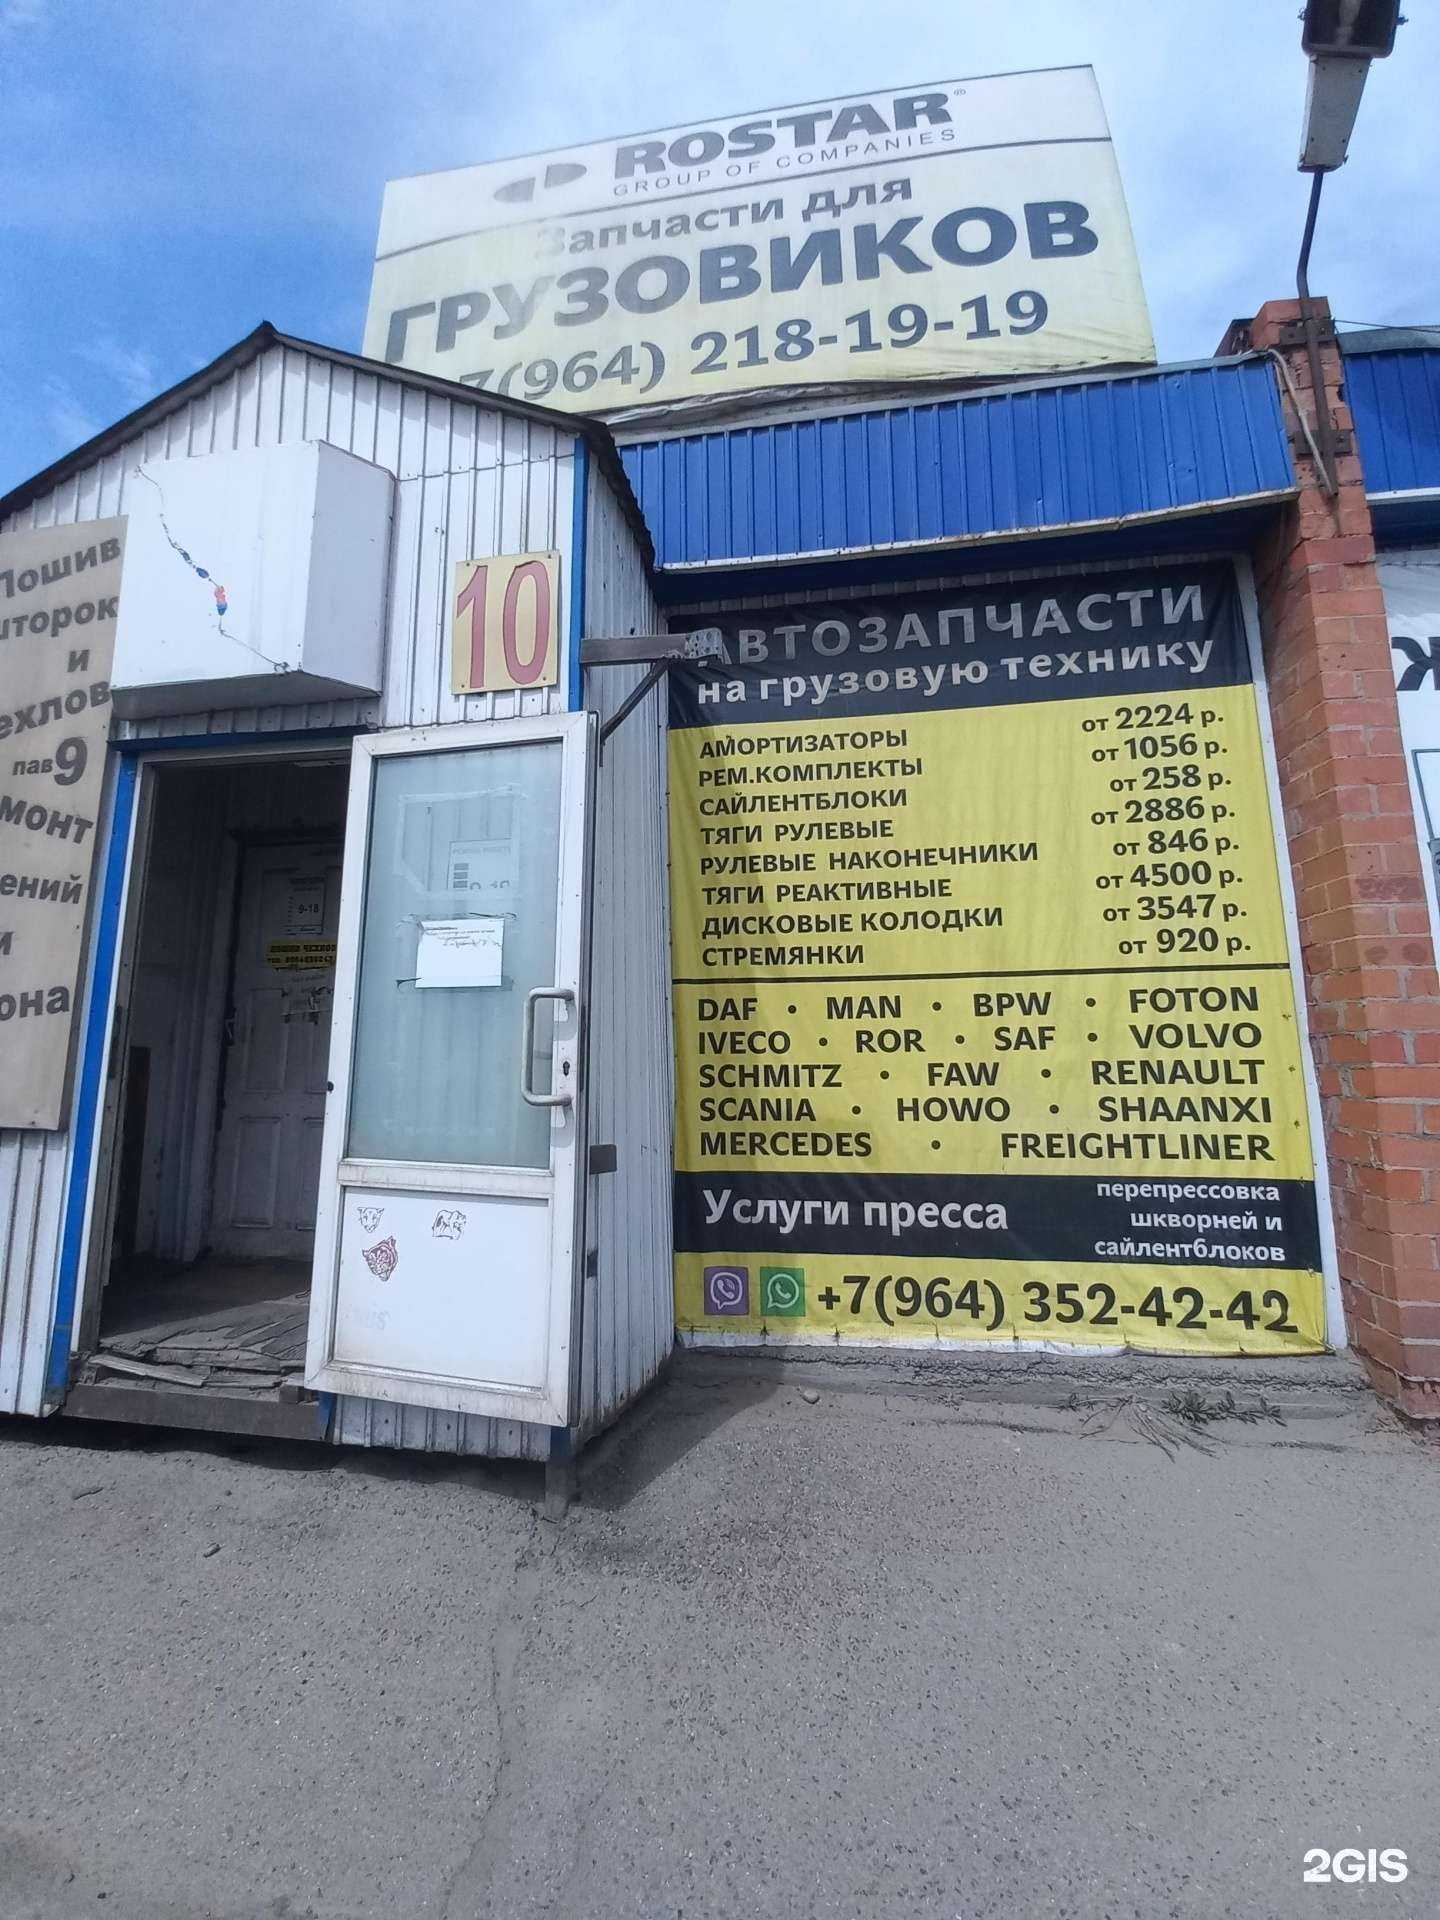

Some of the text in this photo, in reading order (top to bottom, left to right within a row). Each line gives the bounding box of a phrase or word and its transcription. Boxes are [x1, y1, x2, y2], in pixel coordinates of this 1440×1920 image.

[614, 93, 953, 179] ROSTAR
[614, 129, 955, 196] GROUP OF COMPANIES
[535, 178, 912, 258] Запчасти для
[386, 201, 1099, 363] ГРУЗОВИКОВ
[690, 290, 1050, 374] 218-19-19
[457, 561, 550, 688] 10
[67, 650, 90, 672] и
[698, 637, 1214, 708] на грузовую технику
[0, 681, 112, 740] ехлов
[699, 703, 1223, 759] АМОРТИЗАТОРЫ от 2224 р.
[698, 733, 1227, 787] РЕМ.КОМПЛЕКТЫ от 1056 р.
[700, 764, 1231, 816] САЙЛЕНТБЛОКИ от 258 р.
[0, 795, 93, 844] монт
[700, 796, 1235, 844] ТЯГИ РУЛЕВЫЕ от 2886 р.
[700, 828, 1239, 875] РУЛЕВЫЕ НАКОНЕЧНИКИ от 846 р.
[0, 874, 83, 904] ений
[702, 861, 1242, 905] ТЯГИ РЕАКТИВНЫЕ от 4500 р.
[701, 894, 1247, 940] ДИСКОВЫЕ КОЛОДКИ от 3547 р.
[702, 927, 1250, 966] СТРЕМЯНКИ от 920 р.
[0, 985, 70, 1021] она
[699, 987, 1258, 1021] DAF MAN BPW FOTON
[699, 1023, 1261, 1054] IVECO ROR SAF VOLVO
[700, 1060, 1265, 1088] SCHMITZ FAW RENAULT
[700, 1096, 1271, 1122] SCANIA HOWO SHAANXI
[701, 1132, 1275, 1161] MERCEDES FREIGHTLINER
[702, 1189, 1009, 1237] Услуги пресса
[1096, 1181, 1281, 1206] перепрессовка
[1129, 1209, 1282, 1234] шкворней и
[1094, 1236, 1286, 1263] сайлентблоков
[818, 1275, 1298, 1335] +7(964) 352-42-42
